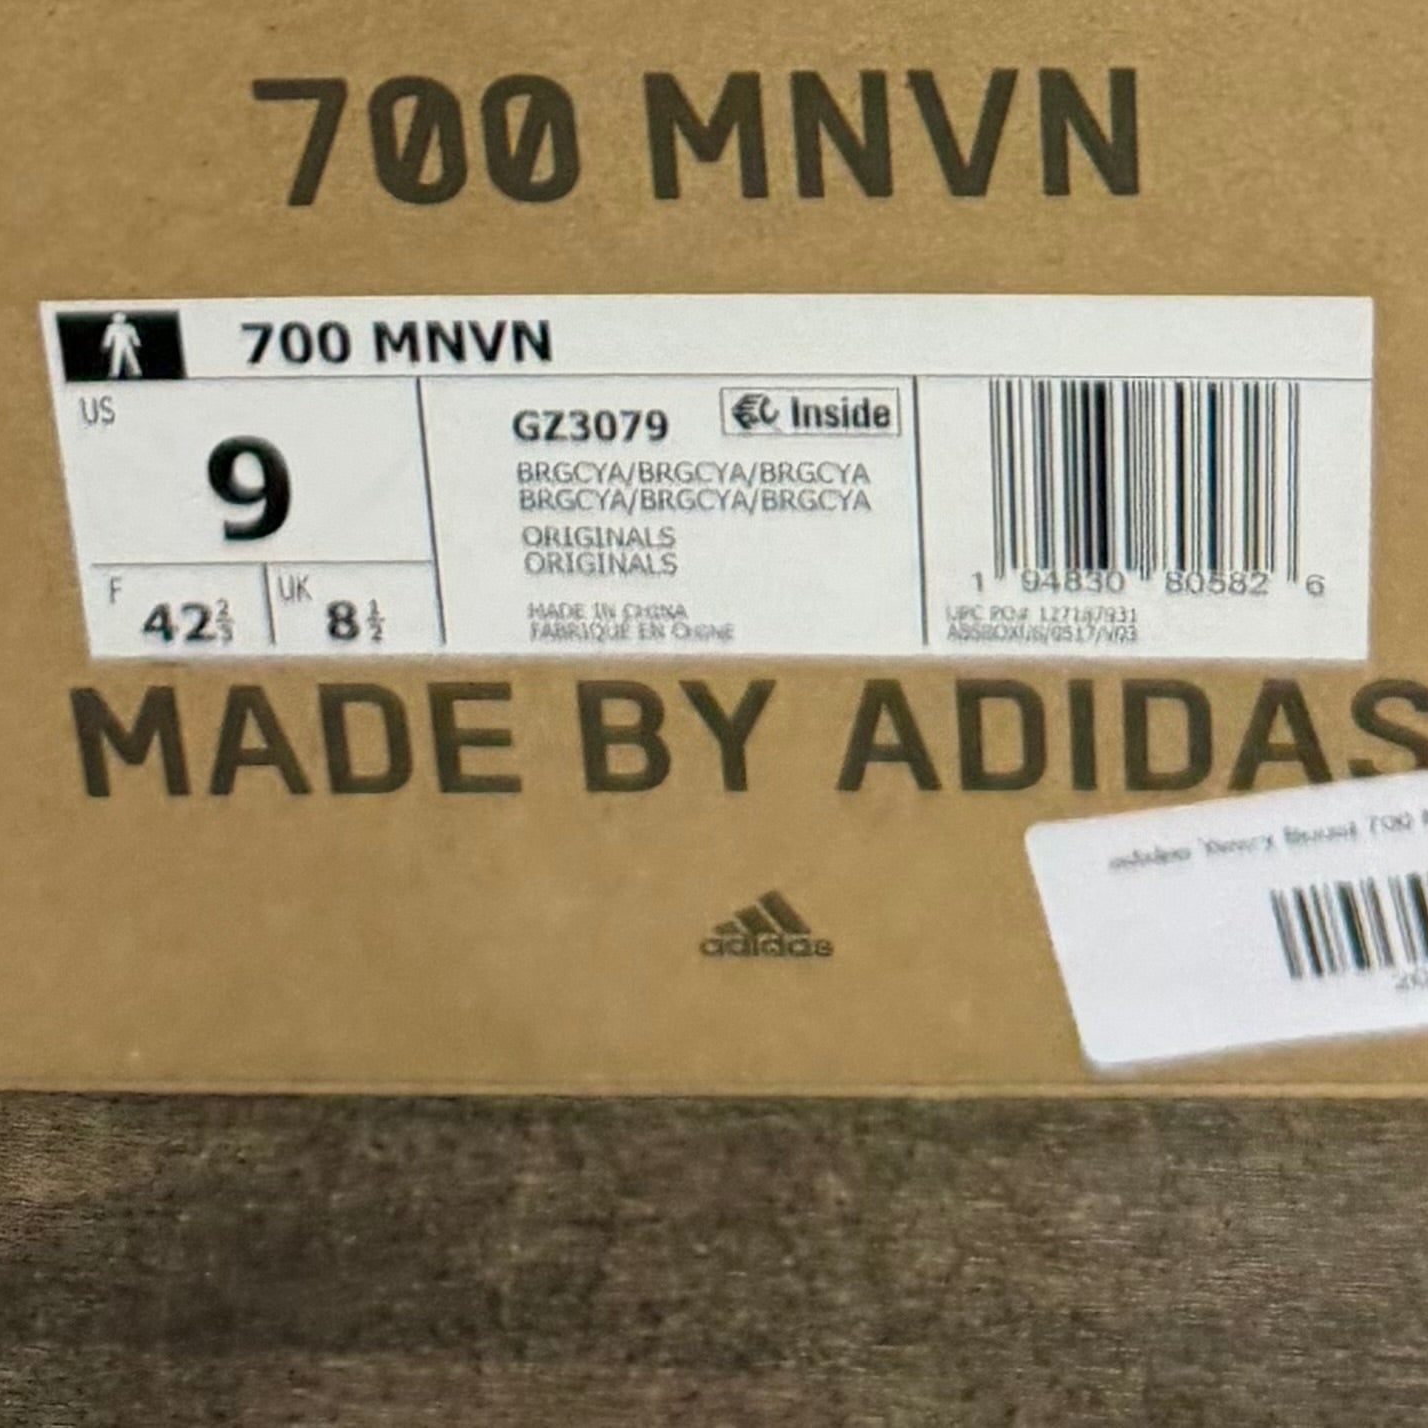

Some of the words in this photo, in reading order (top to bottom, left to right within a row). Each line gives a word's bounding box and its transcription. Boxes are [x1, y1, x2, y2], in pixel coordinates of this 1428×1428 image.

[251, 74, 581, 207] 700
[643, 67, 1140, 201] MNVN
[241, 321, 351, 365] 700
[373, 320, 553, 363] MNVN
[78, 395, 116, 426] US
[790, 396, 891, 430] Inside
[512, 409, 670, 443] GZ3079
[206, 435, 291, 542] 9
[516, 460, 871, 487] BRGCYA/BRGCYA/BRGCYA
[518, 487, 873, 515] BRGCYA/BRGCYA/BRGCYA
[521, 525, 677, 548] ORIGINALS
[523, 551, 679, 576] ORIGINALS
[108, 576, 122, 604] F
[276, 574, 313, 603] UK
[971, 570, 984, 593] 1
[1020, 569, 1126, 594] 94830
[1304, 573, 1326, 598] 6
[69, 681, 521, 798] MADE
[575, 679, 776, 794] BY
